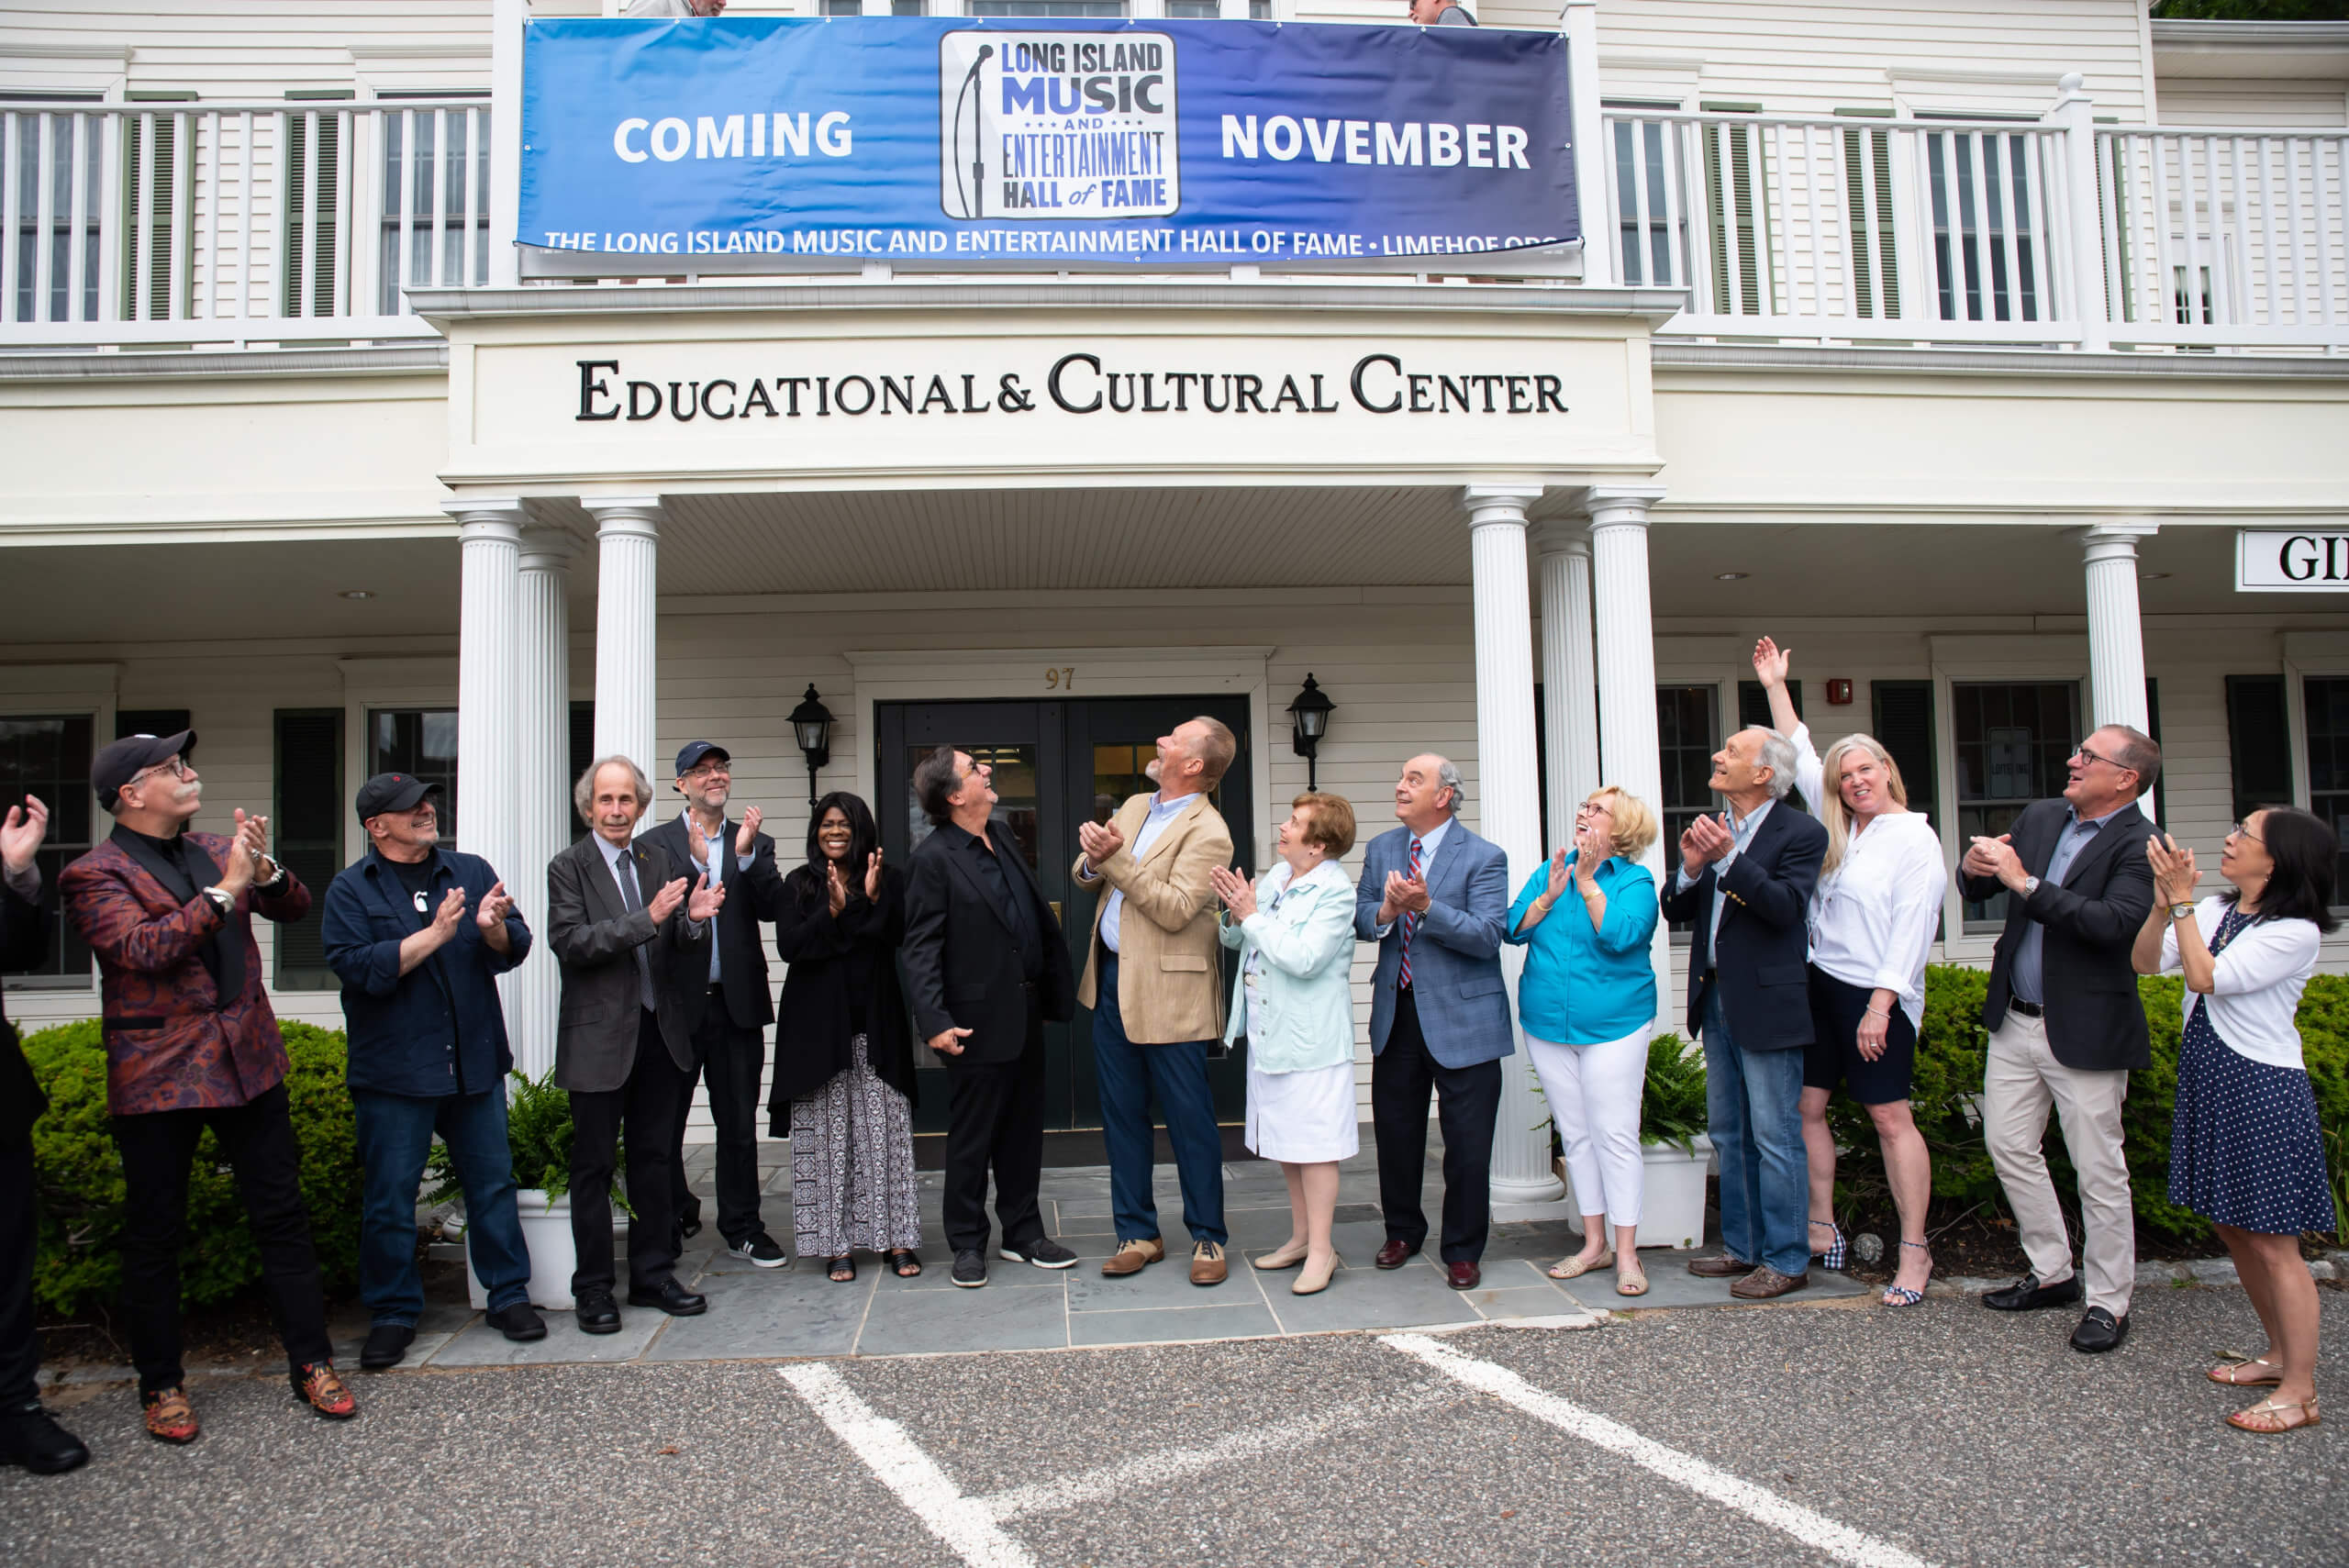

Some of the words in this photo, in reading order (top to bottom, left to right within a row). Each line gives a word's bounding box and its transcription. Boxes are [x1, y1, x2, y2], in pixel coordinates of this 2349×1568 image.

[1001, 43, 1065, 72] LONG
[1074, 43, 1163, 72] ISLAND
[1002, 74, 1163, 115] MUSIC
[614, 111, 852, 163] COMING
[1064, 117, 1104, 130] AND
[1221, 115, 1531, 170] NOVEMBER
[1003, 131, 1164, 177] ENTERTAINMENT
[1003, 182, 1063, 208] HALL
[1069, 183, 1097, 205] of
[1101, 179, 1166, 207] FAME
[545, 232, 596, 250] THE
[604, 232, 678, 253] LONG
[688, 230, 785, 253] ISLAND
[793, 229, 883, 253] MUSIC
[888, 230, 948, 252] AND
[956, 229, 1174, 252] ENTERTAINMENT
[1181, 229, 1246, 253] HALL
[1252, 230, 1285, 254] OF
[1293, 232, 1364, 255] FAME
[575, 359, 990, 422] EDUCATIONAL
[1048, 352, 1339, 413] CULTURAL
[1350, 353, 1569, 413] CENTER
[2279, 536, 2349, 581] GI
[1045, 667, 1075, 690] 97
